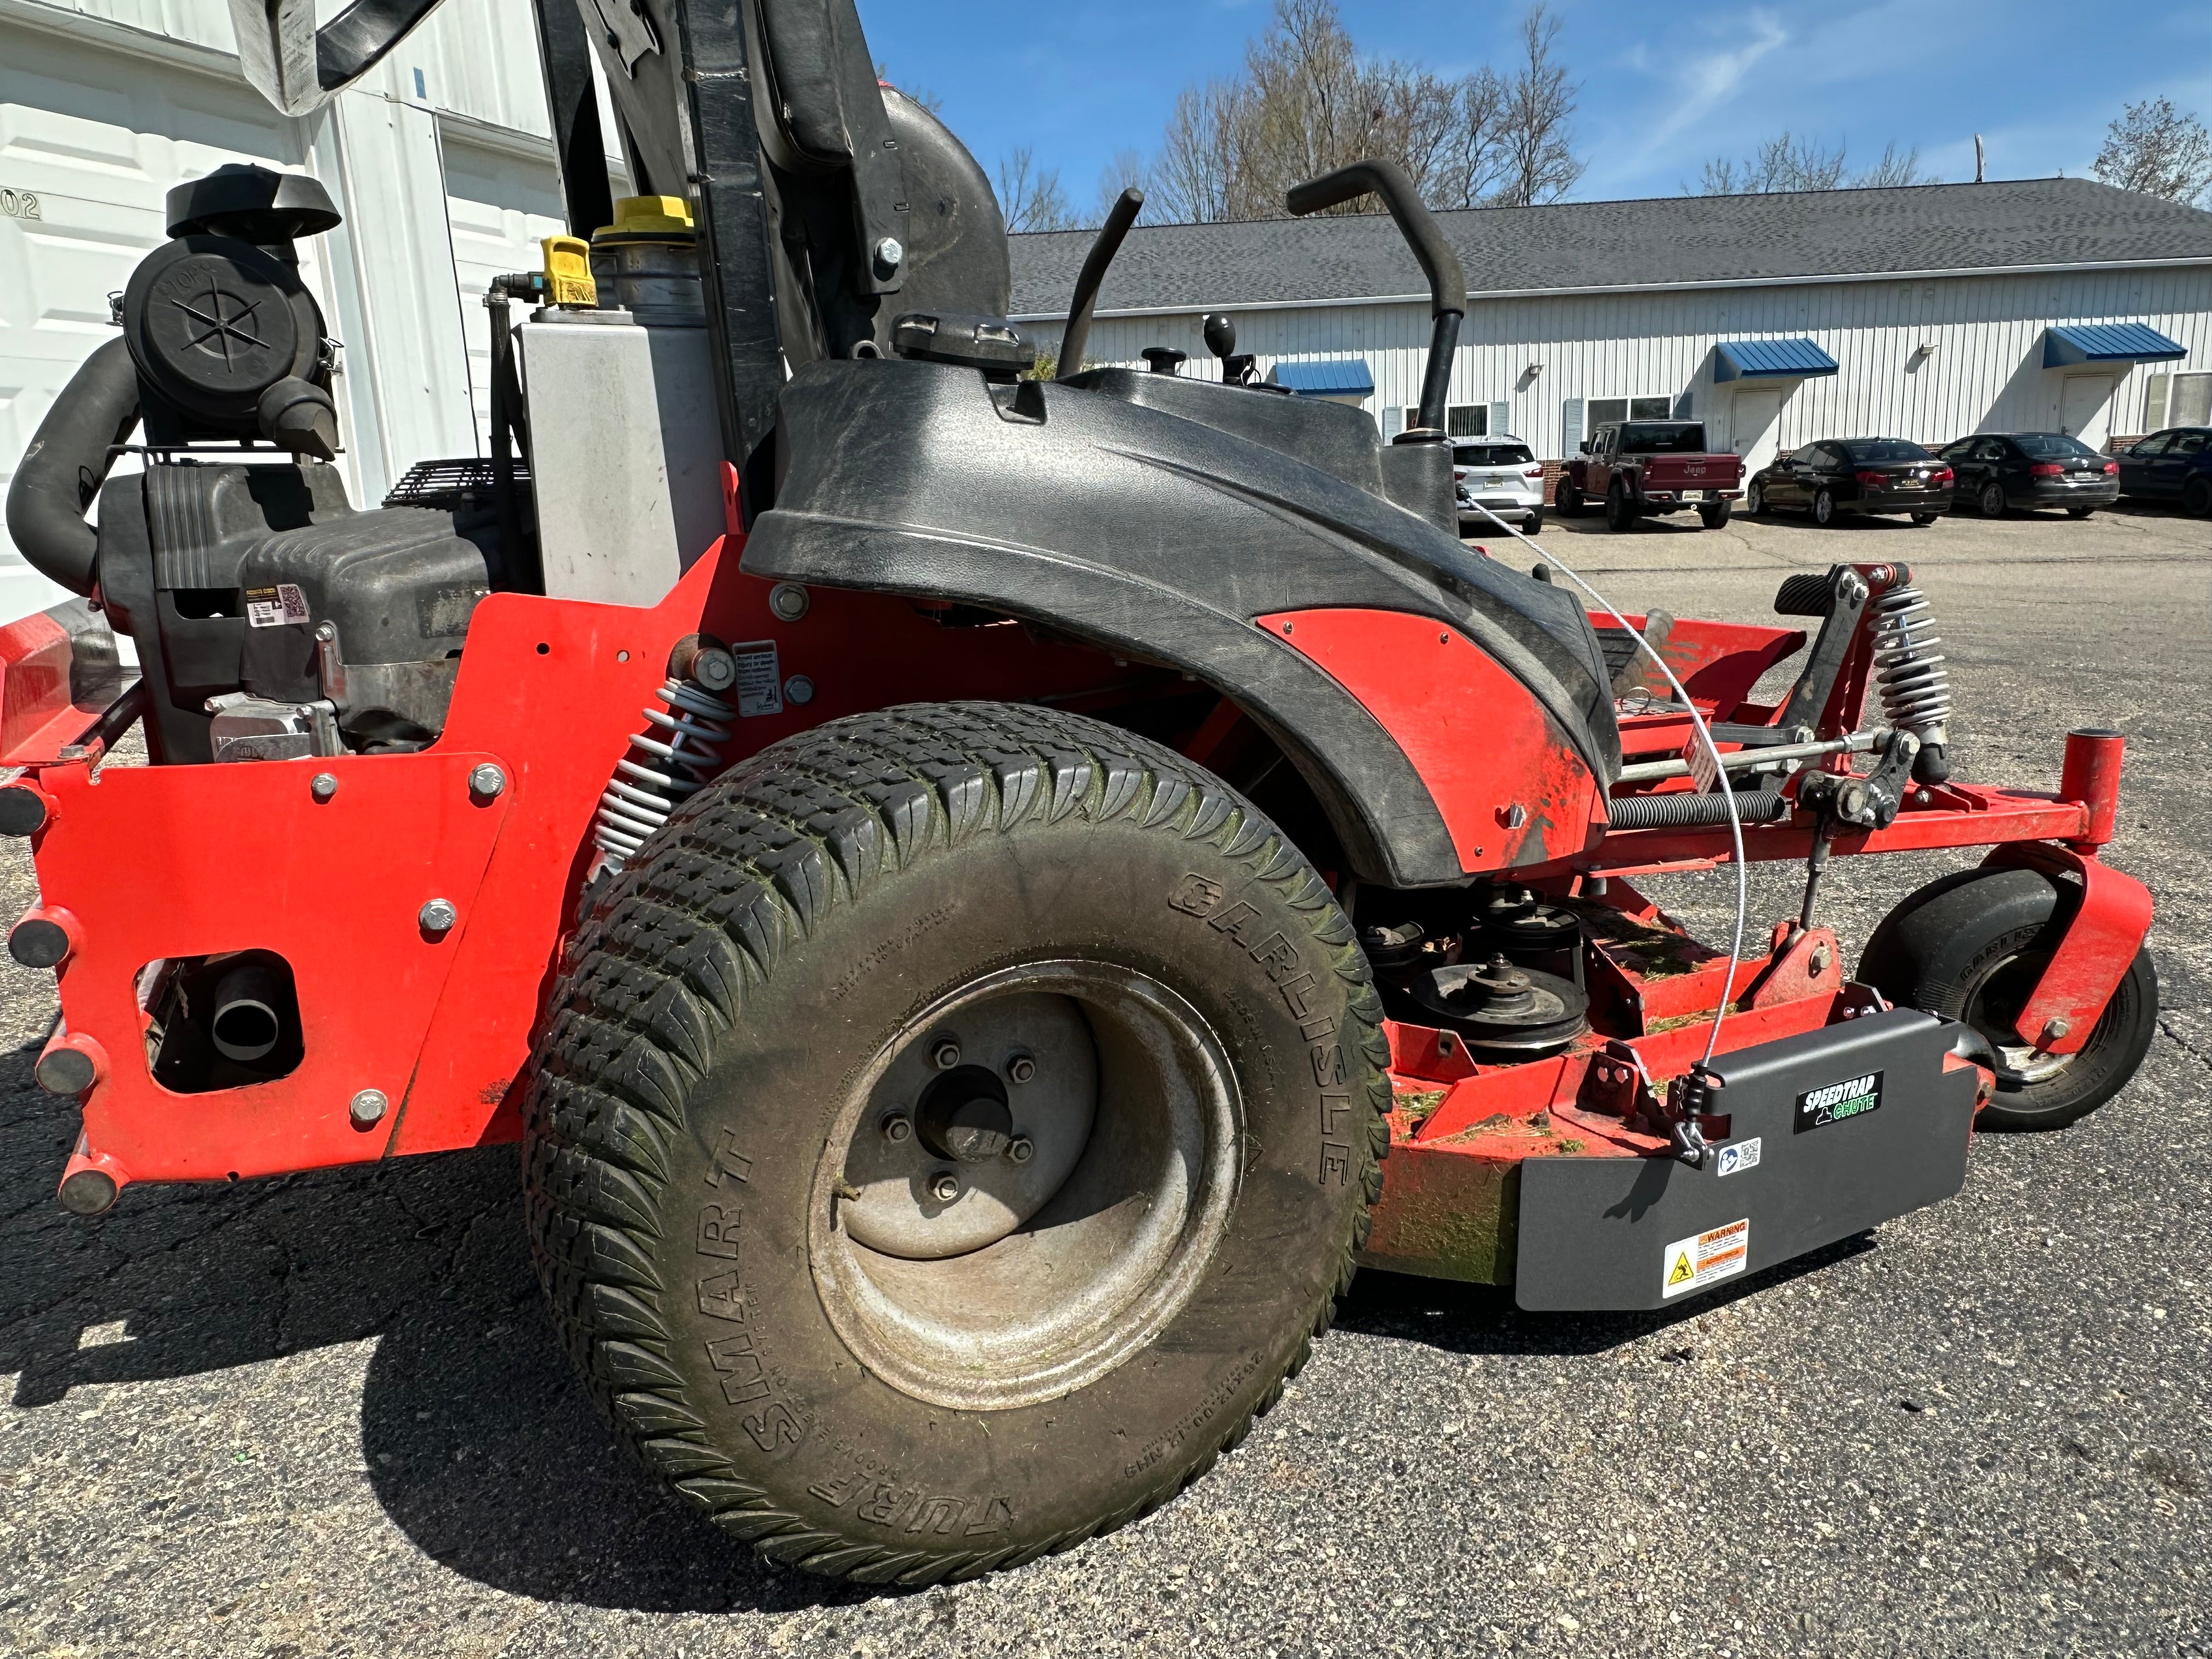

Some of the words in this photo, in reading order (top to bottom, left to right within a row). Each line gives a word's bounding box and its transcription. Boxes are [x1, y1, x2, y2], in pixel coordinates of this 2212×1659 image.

[1, 189, 40, 219] 02
[1167, 871, 1350, 1186] CARLISLE
[1803, 1075, 1875, 1114] SPEEDTRAP
[1833, 1092, 1878, 1120] CHUTE
[1707, 1221, 1746, 1242] WARNING
[695, 1126, 804, 1452] SMART
[807, 1470, 1014, 1536] TURF
